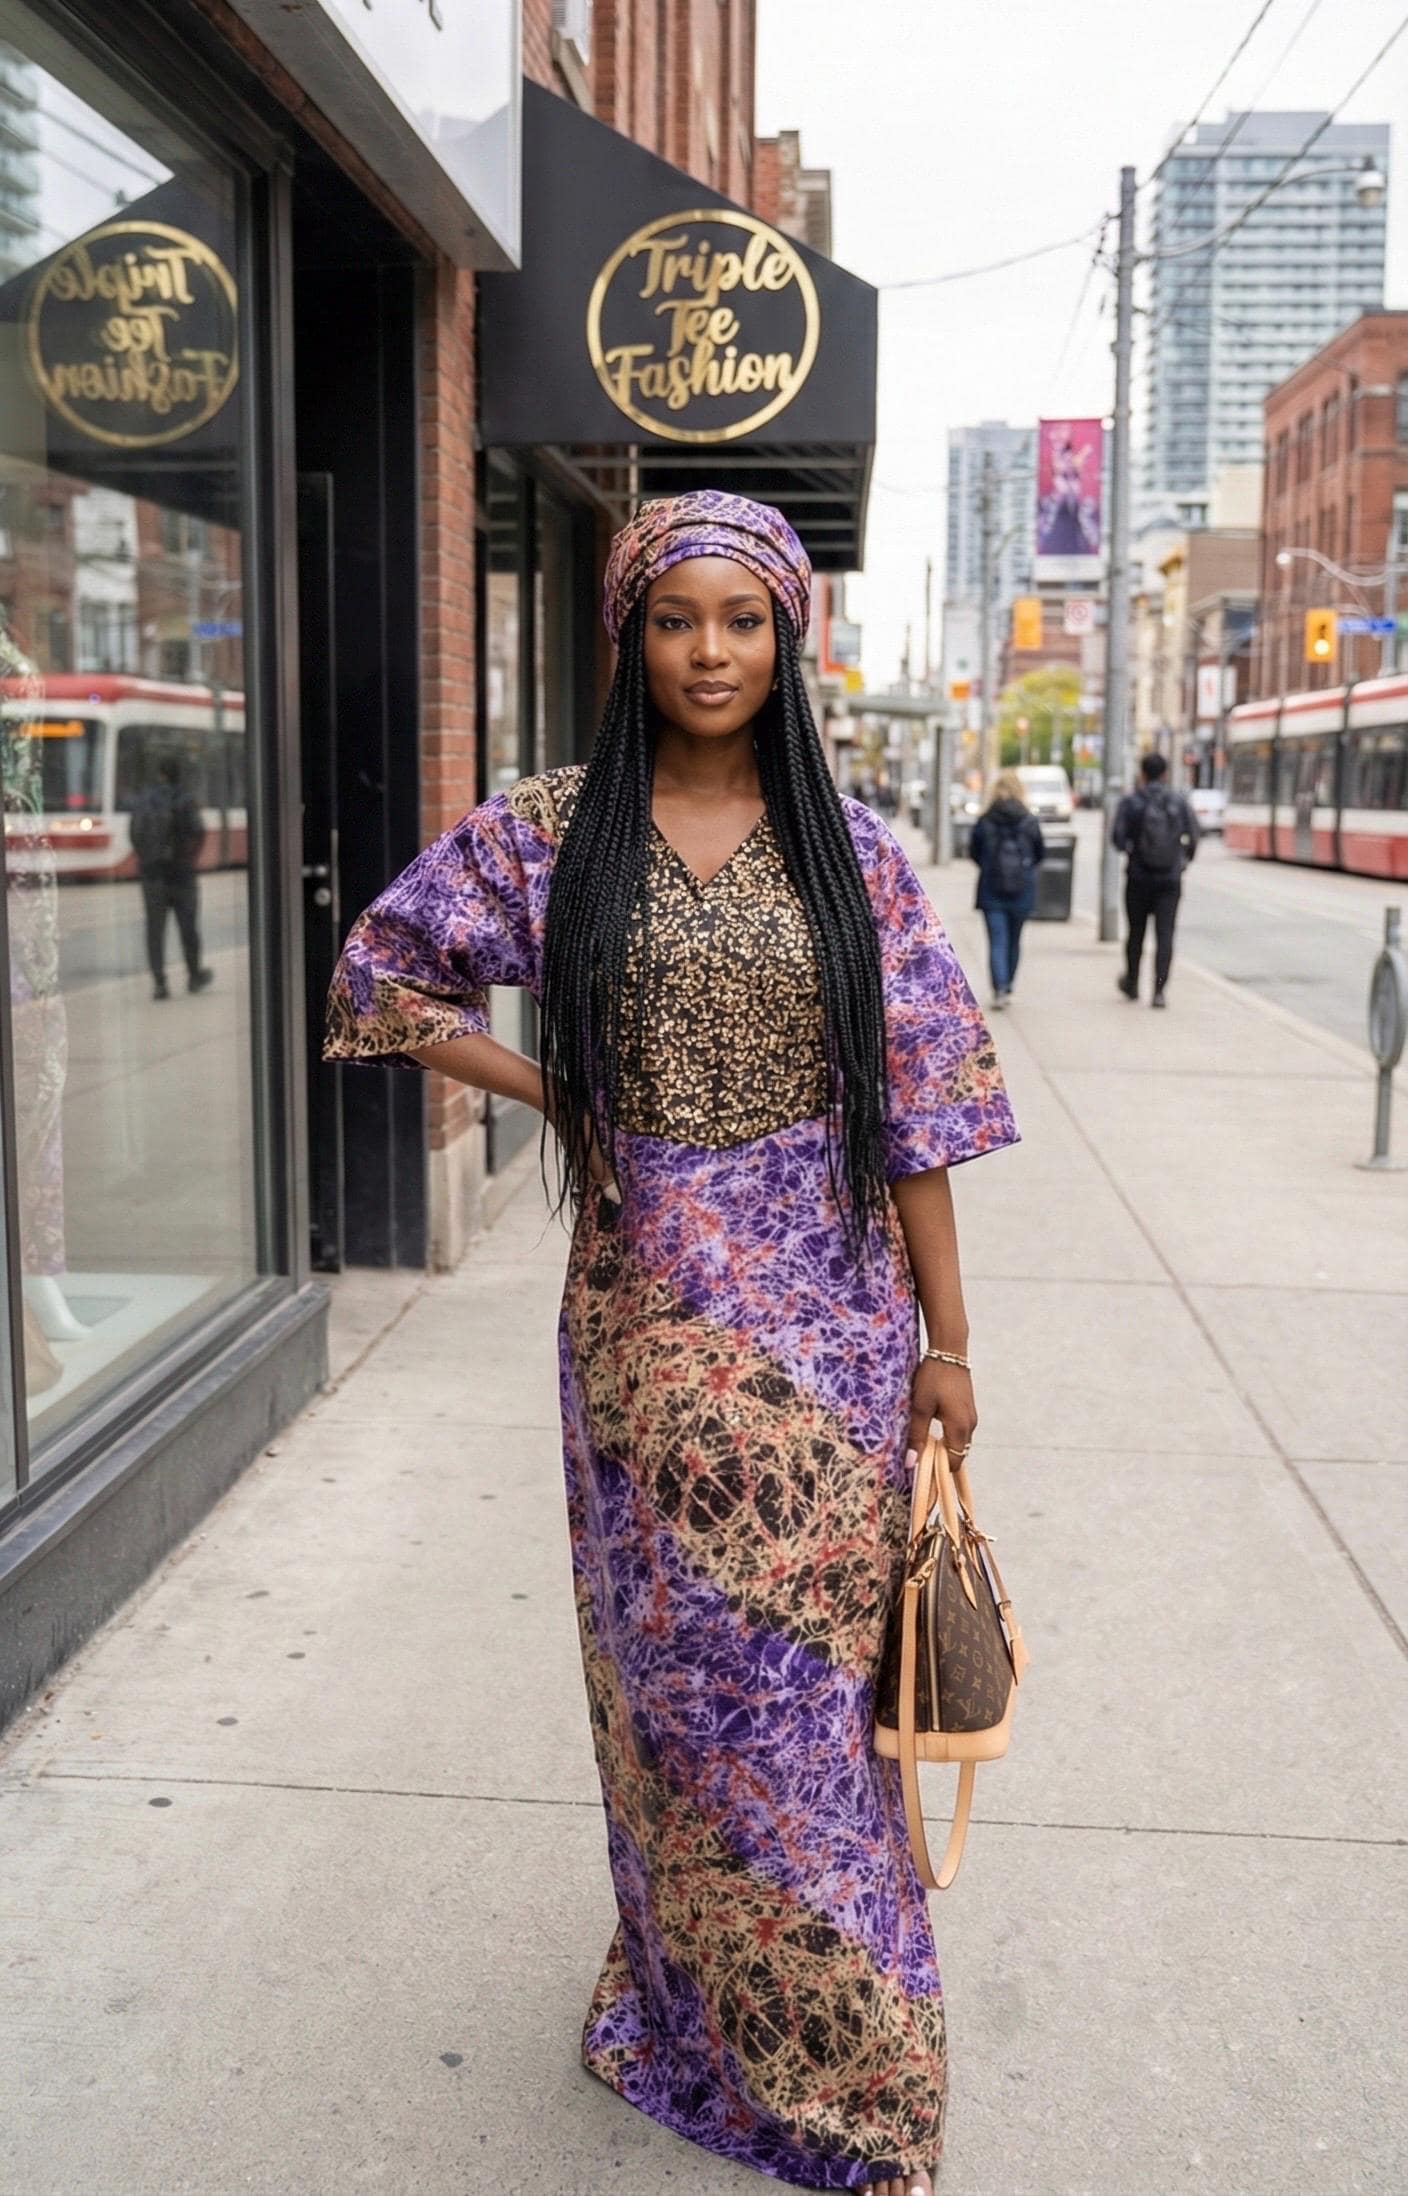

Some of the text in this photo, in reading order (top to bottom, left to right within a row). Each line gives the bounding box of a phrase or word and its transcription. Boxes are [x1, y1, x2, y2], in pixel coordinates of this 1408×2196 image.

[629, 233, 794, 305] Triple
[655, 300, 739, 357] Tee
[605, 341, 794, 409] Fashion
